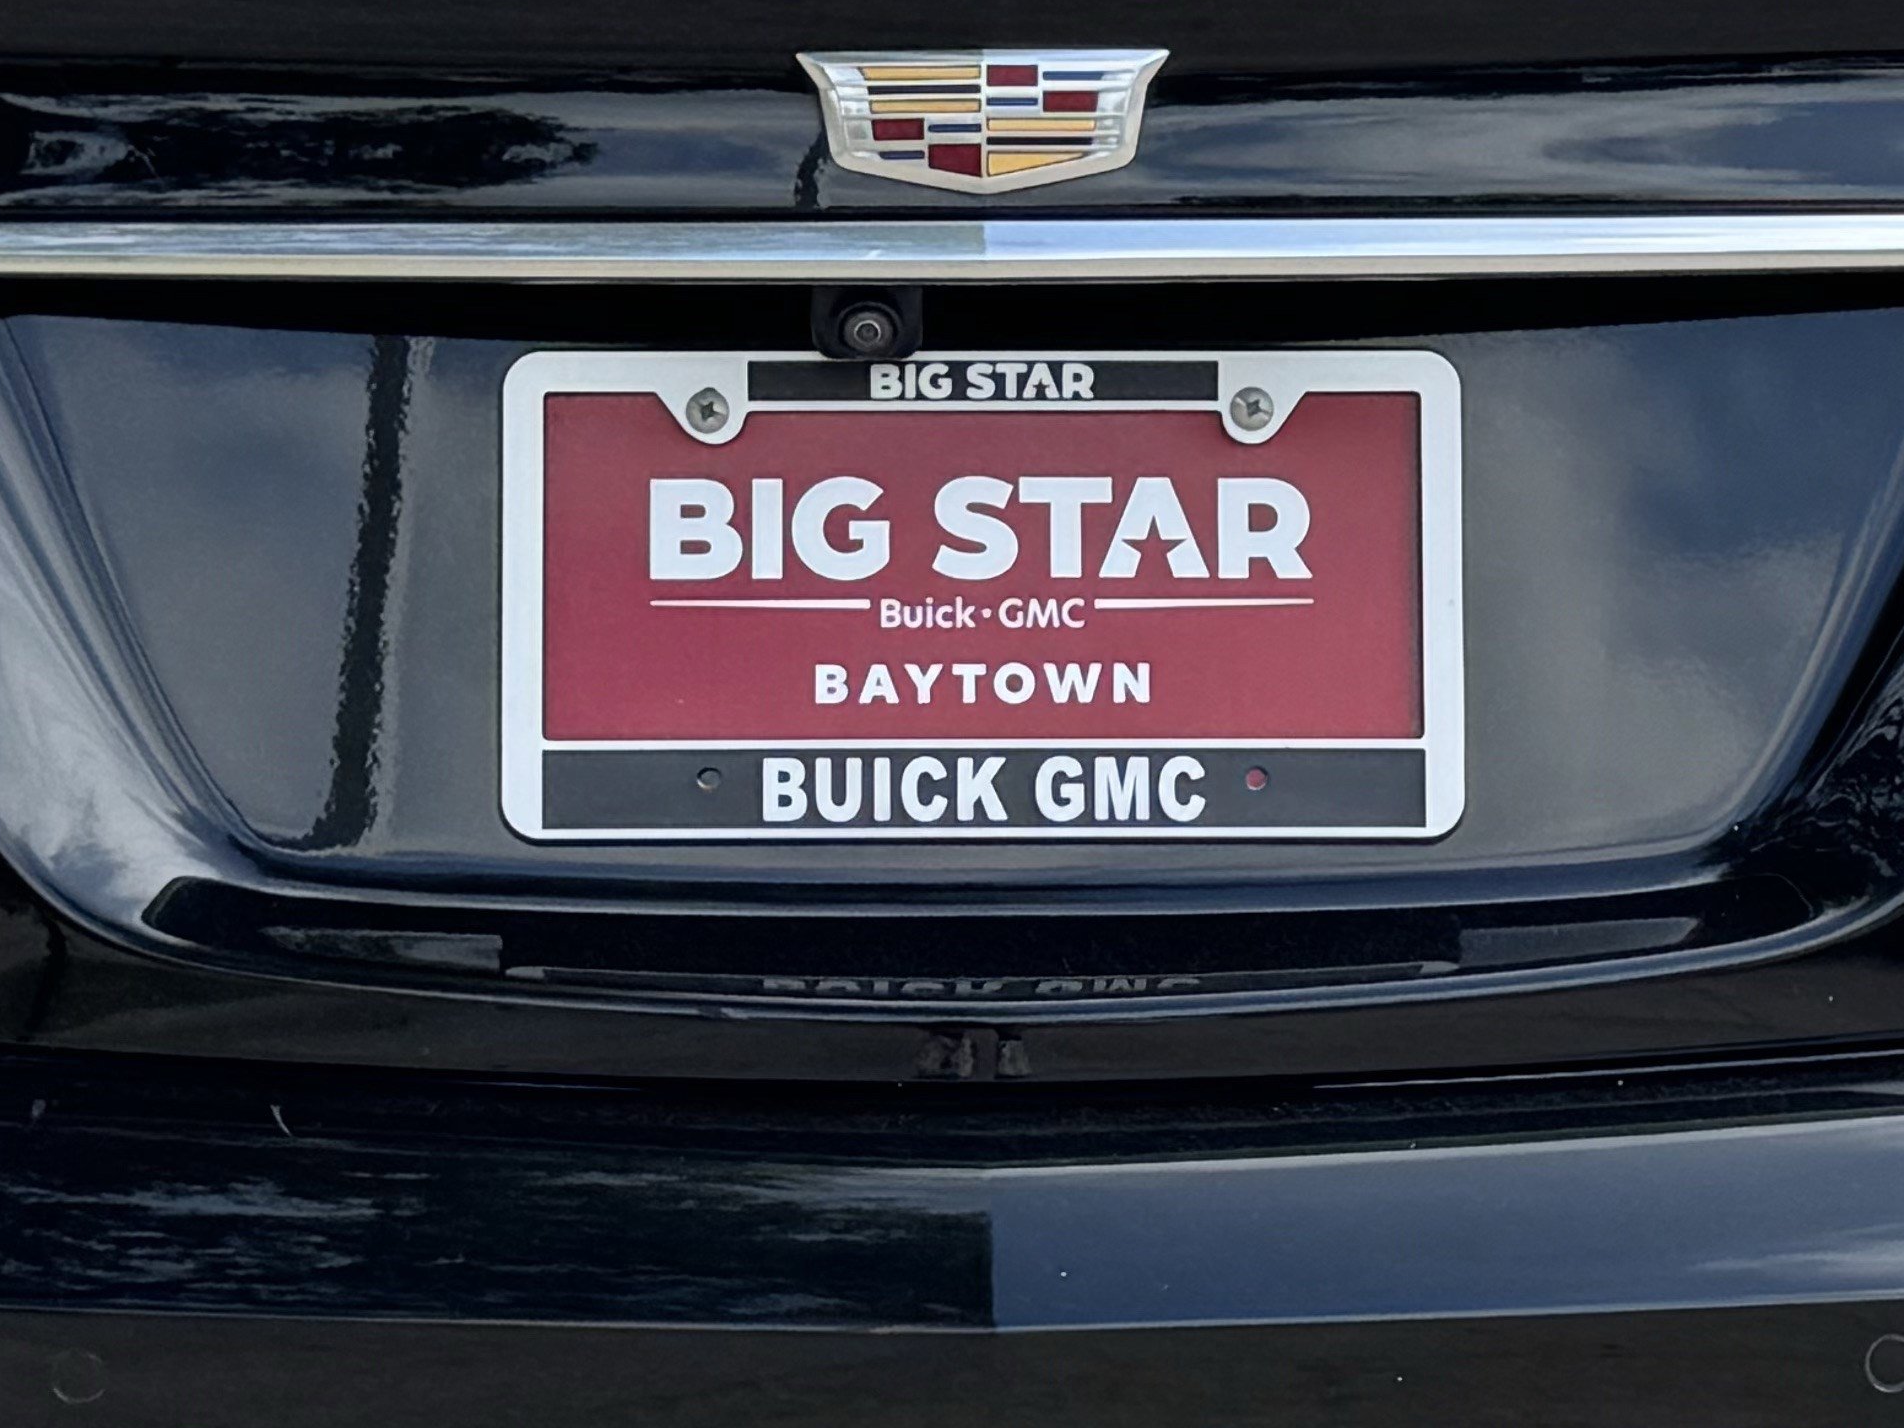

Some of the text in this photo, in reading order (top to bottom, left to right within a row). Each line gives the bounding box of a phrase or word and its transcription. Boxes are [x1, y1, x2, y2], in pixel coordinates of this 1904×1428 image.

[870, 362, 1095, 400] BIG STAR
[649, 475, 1313, 581] BIG STAR
[814, 662, 1151, 705] BAYTOWN
[762, 755, 1206, 823] BUICK GMC
